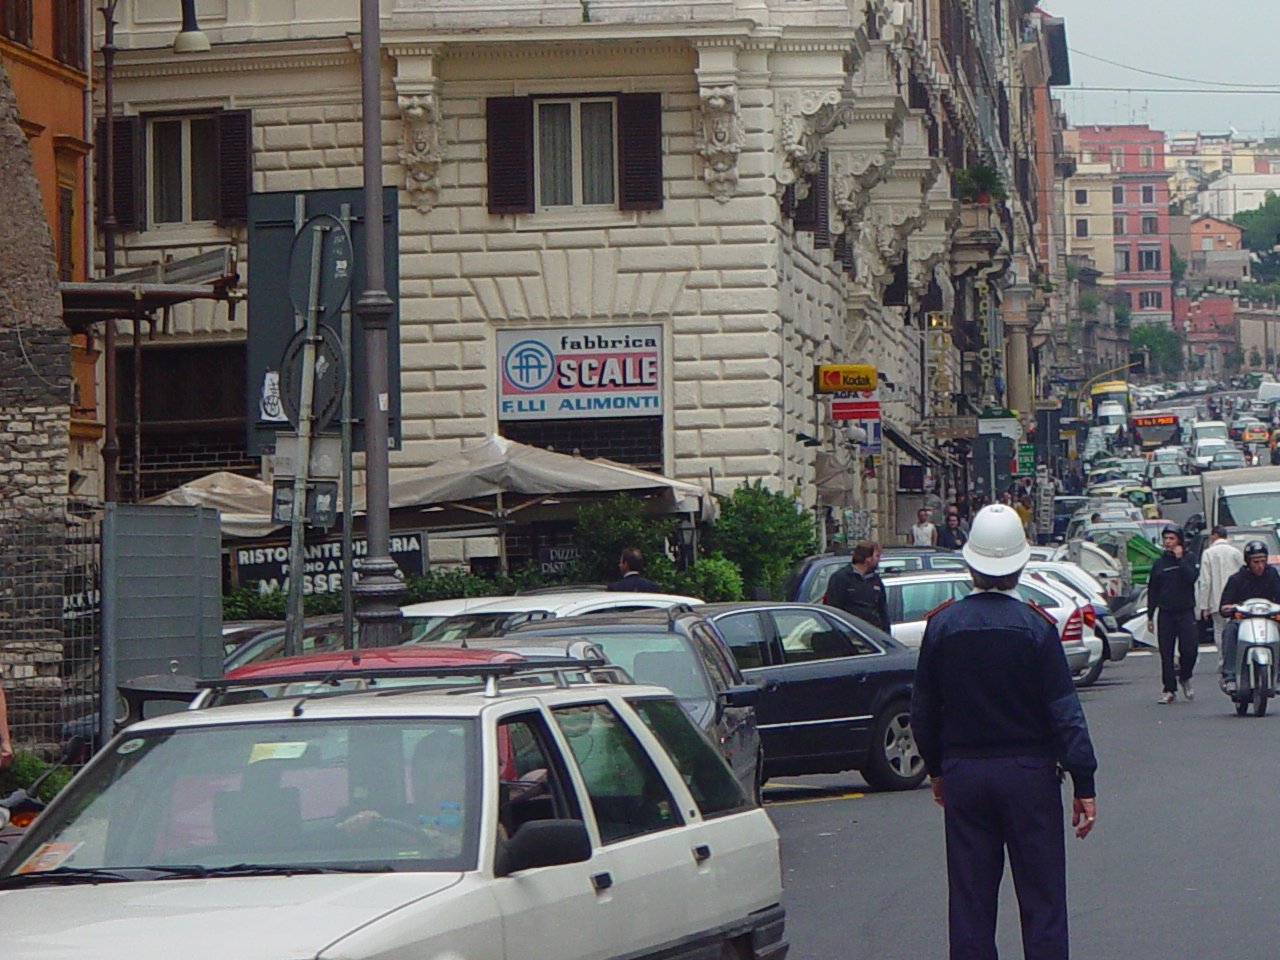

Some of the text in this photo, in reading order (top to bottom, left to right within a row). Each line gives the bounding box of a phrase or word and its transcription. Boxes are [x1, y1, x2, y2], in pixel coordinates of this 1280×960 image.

[560, 334, 657, 350] fabbrica
[558, 356, 657, 389] SCALE
[842, 375, 871, 386] Kodak
[833, 390, 860, 400] AGFA
[502, 395, 660, 413] F.LLI ALIMONTI
